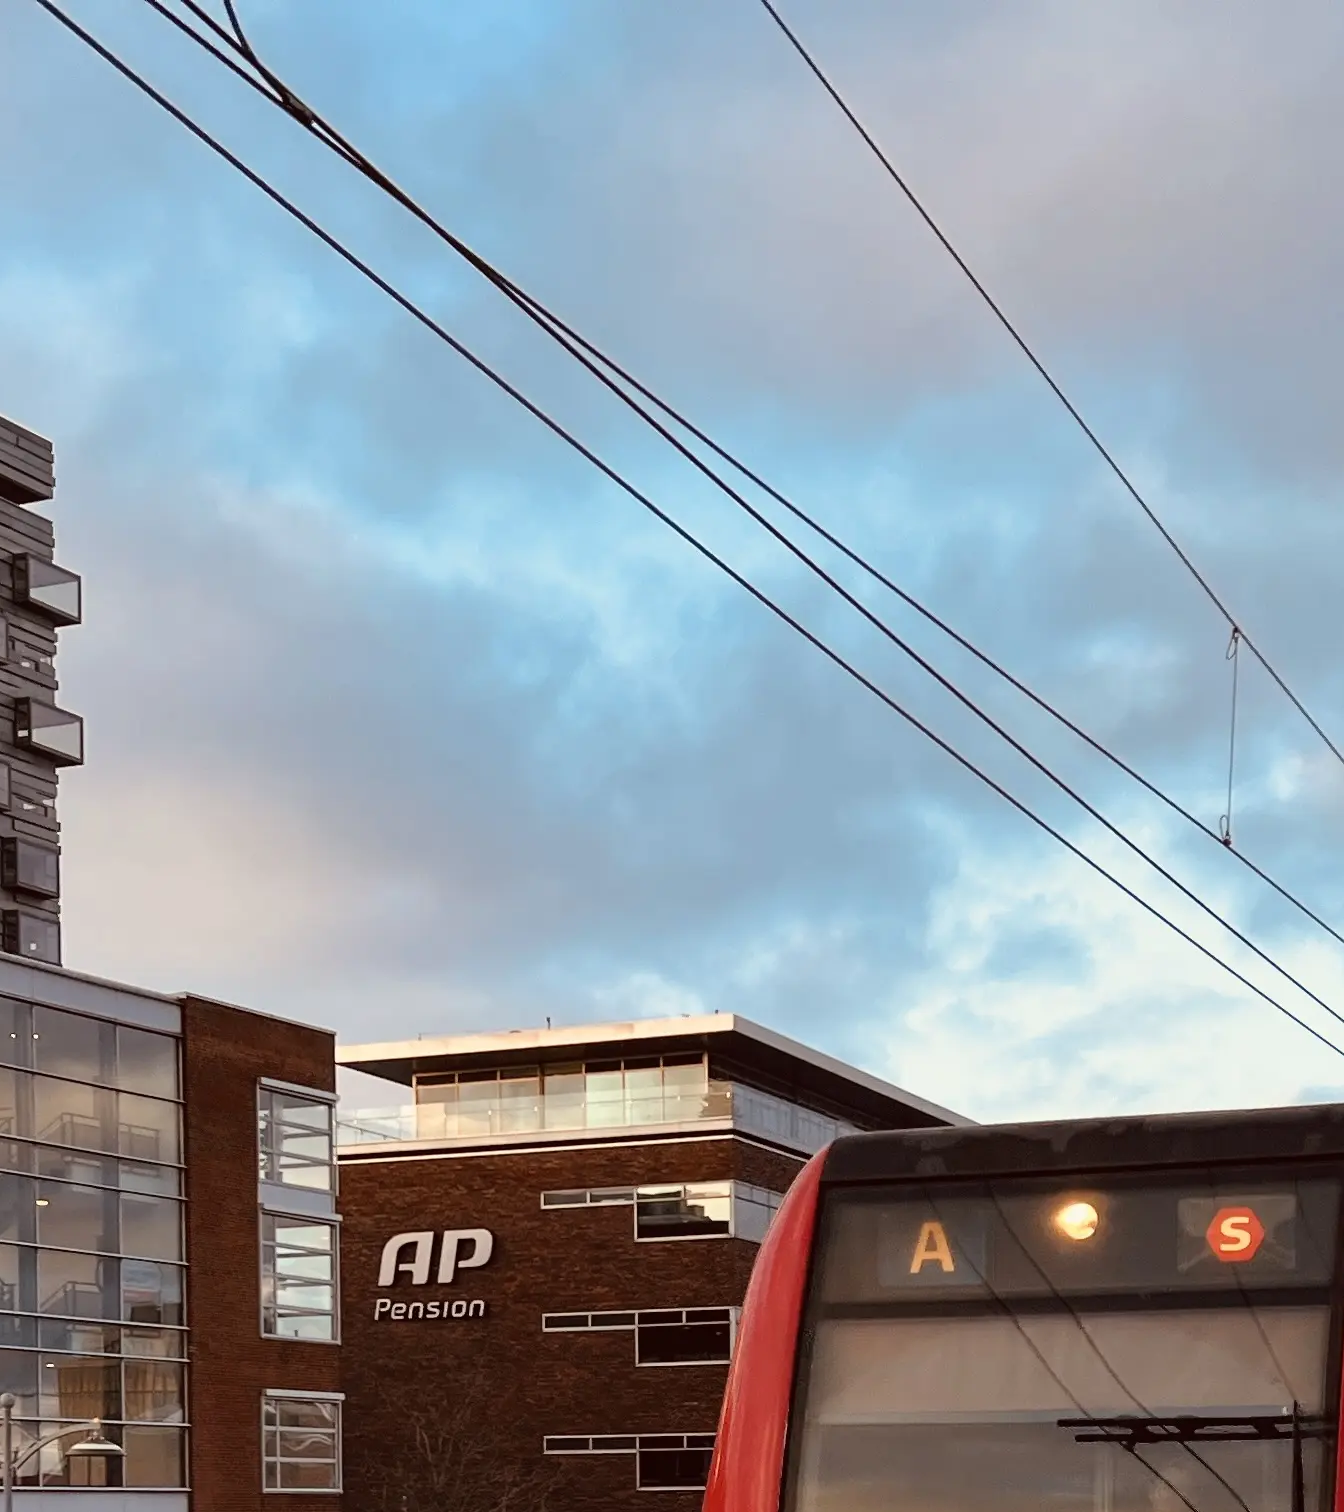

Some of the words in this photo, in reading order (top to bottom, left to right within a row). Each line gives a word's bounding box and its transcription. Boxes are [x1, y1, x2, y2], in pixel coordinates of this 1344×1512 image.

[909, 1221, 956, 1274] A
[1218, 1216, 1252, 1252] S
[377, 1228, 493, 1287] AP
[374, 1298, 485, 1321] Pension
